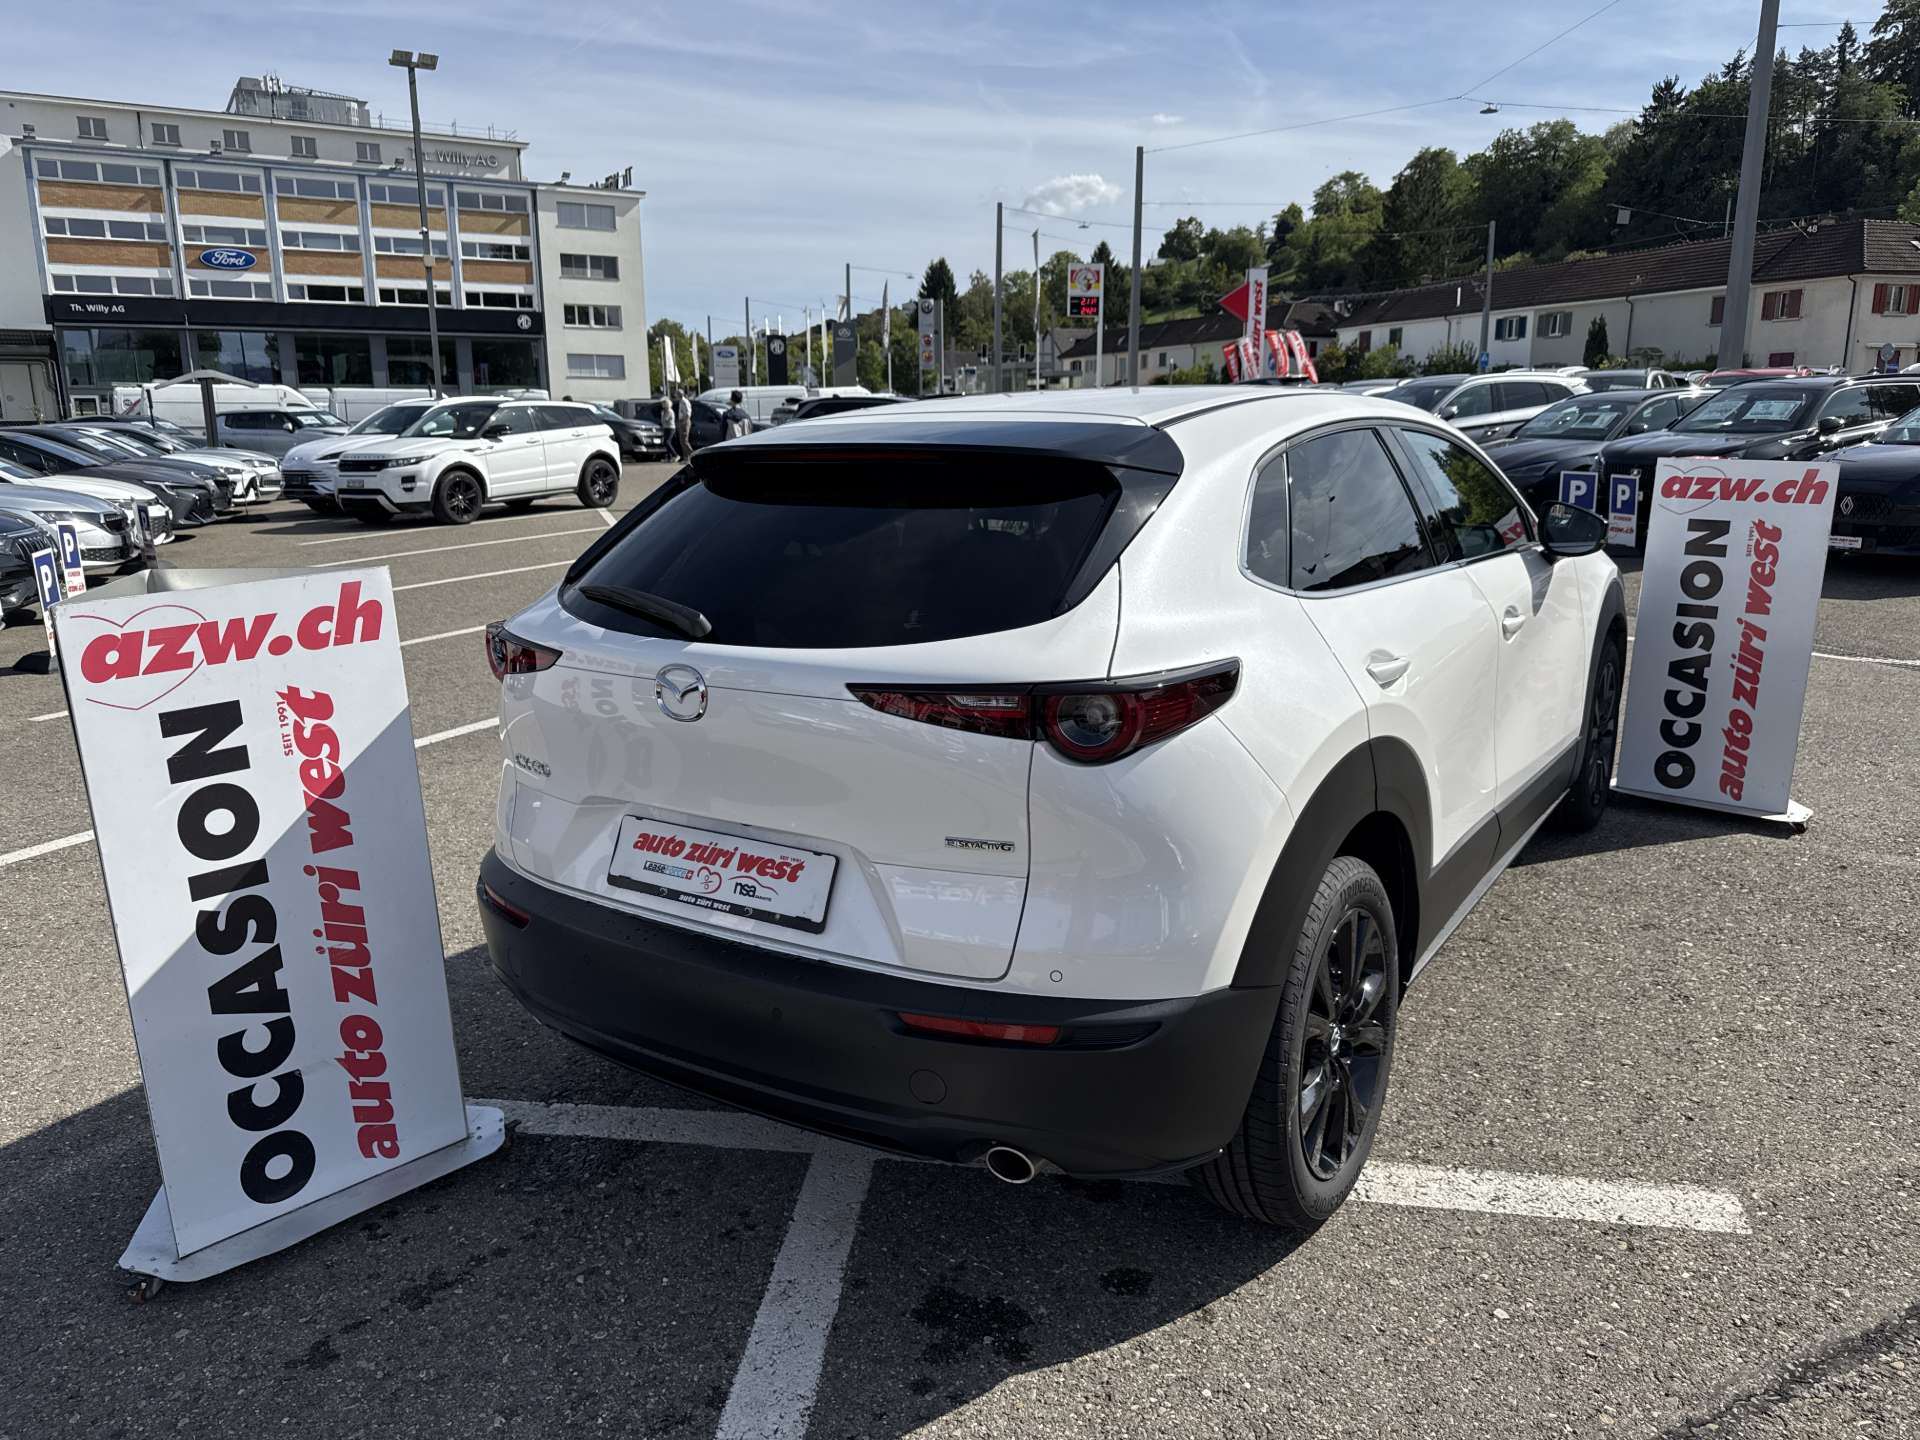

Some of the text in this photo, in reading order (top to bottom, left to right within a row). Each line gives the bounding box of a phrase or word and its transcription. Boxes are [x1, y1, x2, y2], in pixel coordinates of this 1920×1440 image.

[437, 151, 471, 168] Willy
[475, 152, 498, 168] AG
[1806, 224, 1818, 233] 48
[211, 250, 246, 267] Ford
[70, 303, 126, 314] Th. Willy AG
[1568, 480, 1588, 504] P
[1616, 484, 1631, 509] P
[1660, 468, 1830, 505] azw.ch
[62, 532, 75, 563] P
[39, 564, 53, 603] P
[80, 580, 383, 684] azw.ch
[1654, 518, 1732, 790] OCCASION
[1718, 518, 1783, 803] auto züri west
[276, 699, 294, 757] SEIT 1991
[632, 832, 806, 883] auto züri west
[678, 893, 731, 912] auto züri west
[733, 881, 757, 898] nsa
[275, 685, 401, 1160] auto züri west
[158, 699, 316, 1205] OCCASION
